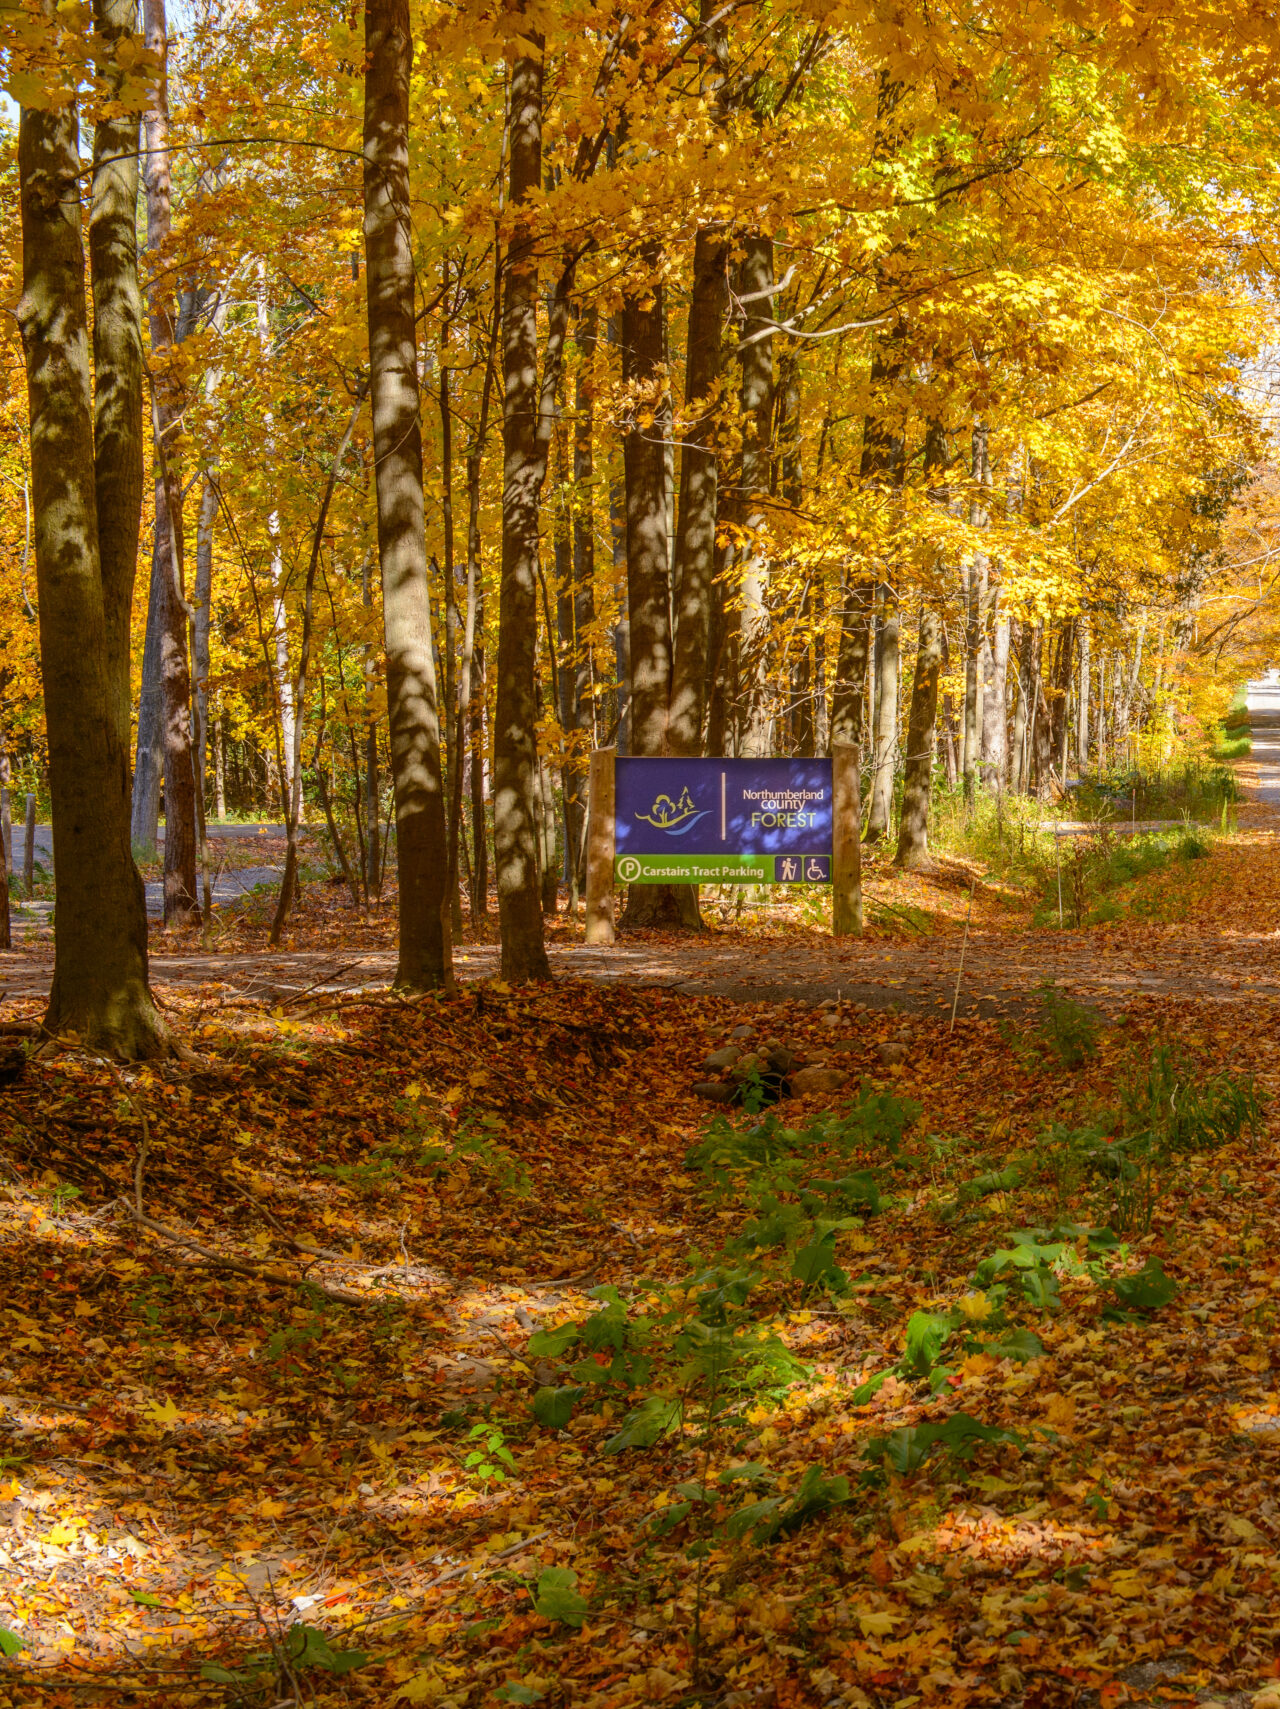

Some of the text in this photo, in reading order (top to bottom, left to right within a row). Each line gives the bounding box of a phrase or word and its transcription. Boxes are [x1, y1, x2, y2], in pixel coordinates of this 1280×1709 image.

[743, 789, 824, 800] Northumberland
[761, 800, 806, 812] county
[751, 812, 816, 828] FOREST
[625, 861, 764, 879] P Carstairs Tract Parking
